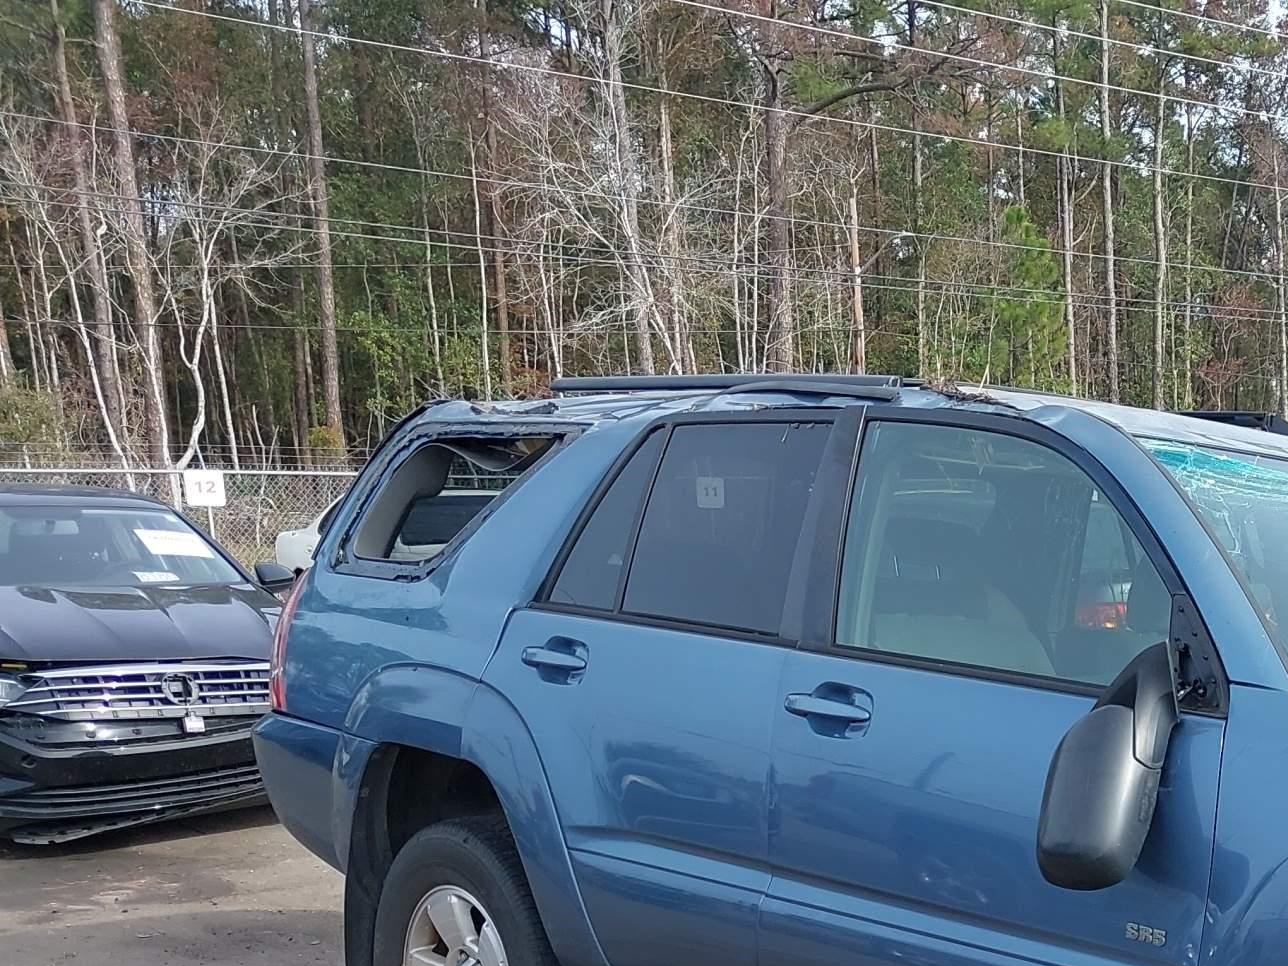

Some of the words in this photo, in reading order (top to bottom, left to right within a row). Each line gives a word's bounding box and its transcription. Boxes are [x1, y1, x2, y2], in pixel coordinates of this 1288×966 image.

[194, 480, 217, 494] 12
[703, 487, 718, 497] 11
[1125, 922, 1166, 947] SR5
